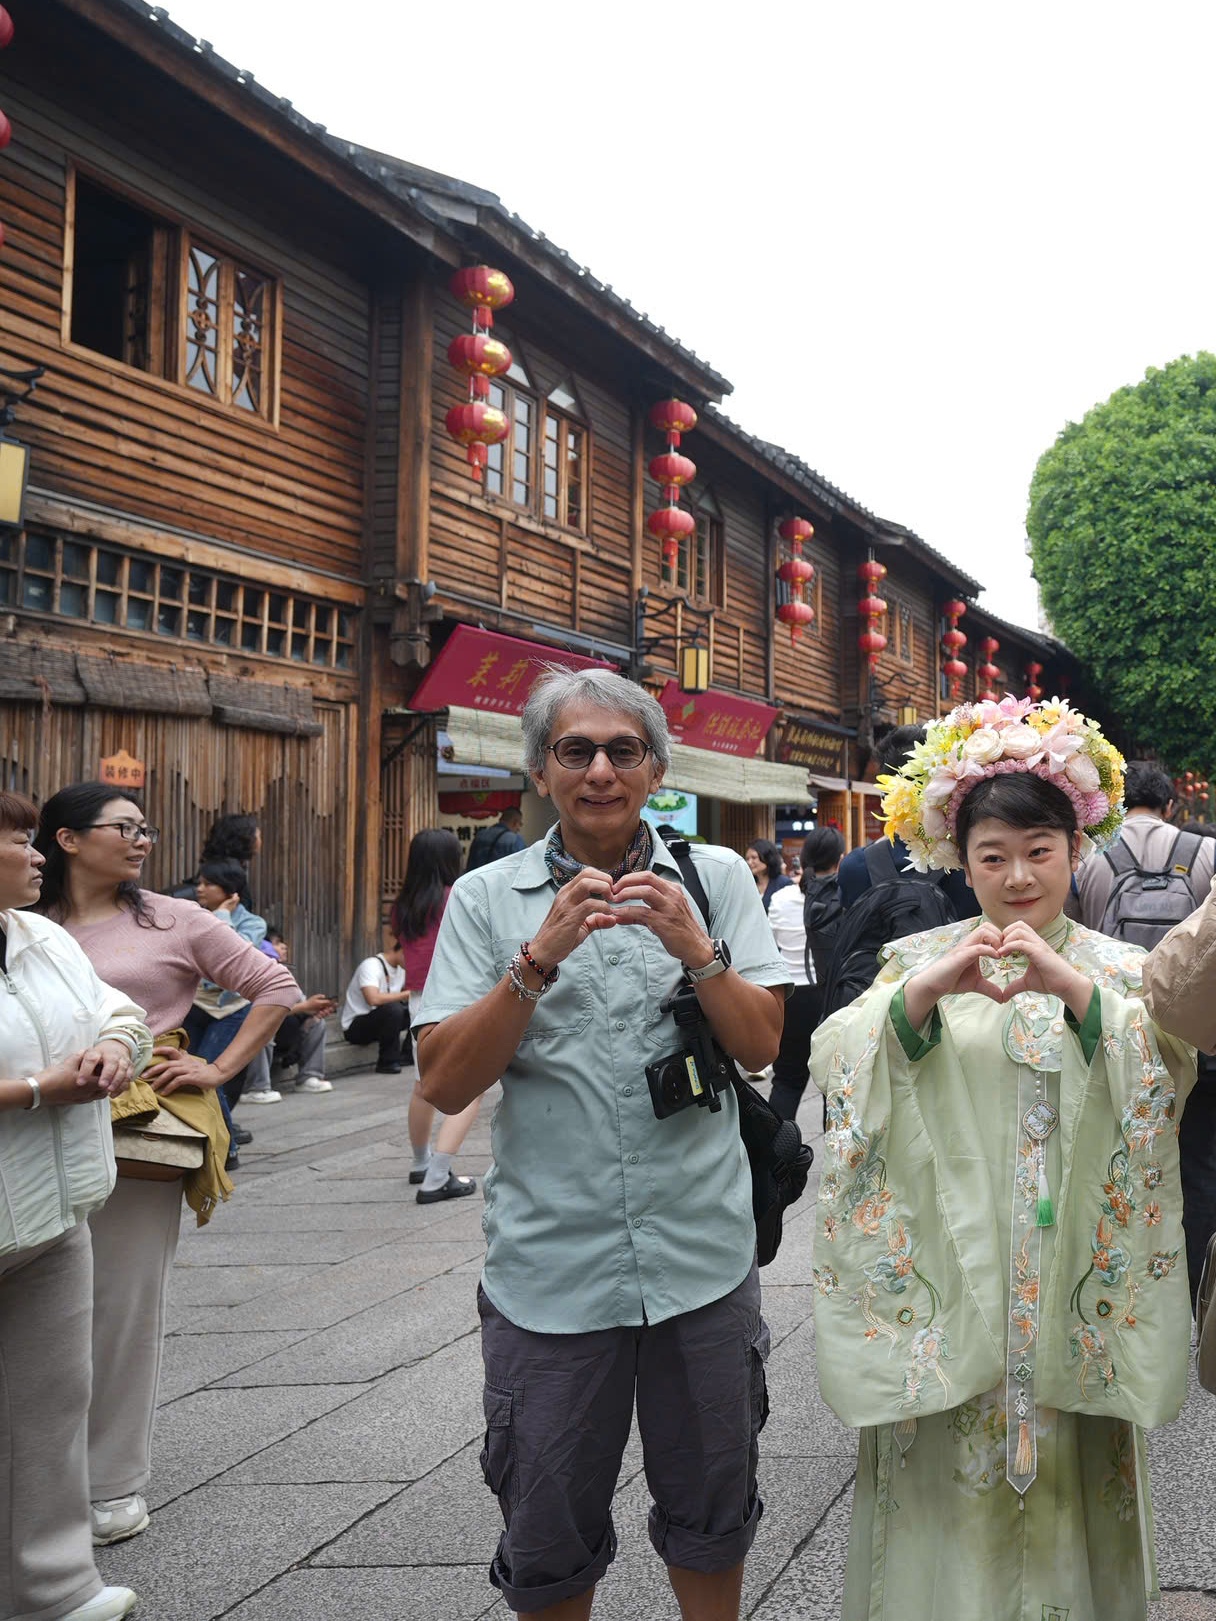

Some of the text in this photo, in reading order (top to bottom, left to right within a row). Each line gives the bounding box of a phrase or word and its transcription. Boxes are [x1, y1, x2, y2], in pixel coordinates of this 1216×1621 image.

[466, 651, 542, 697] 茉莉
[105, 764, 141, 780] 装修中
